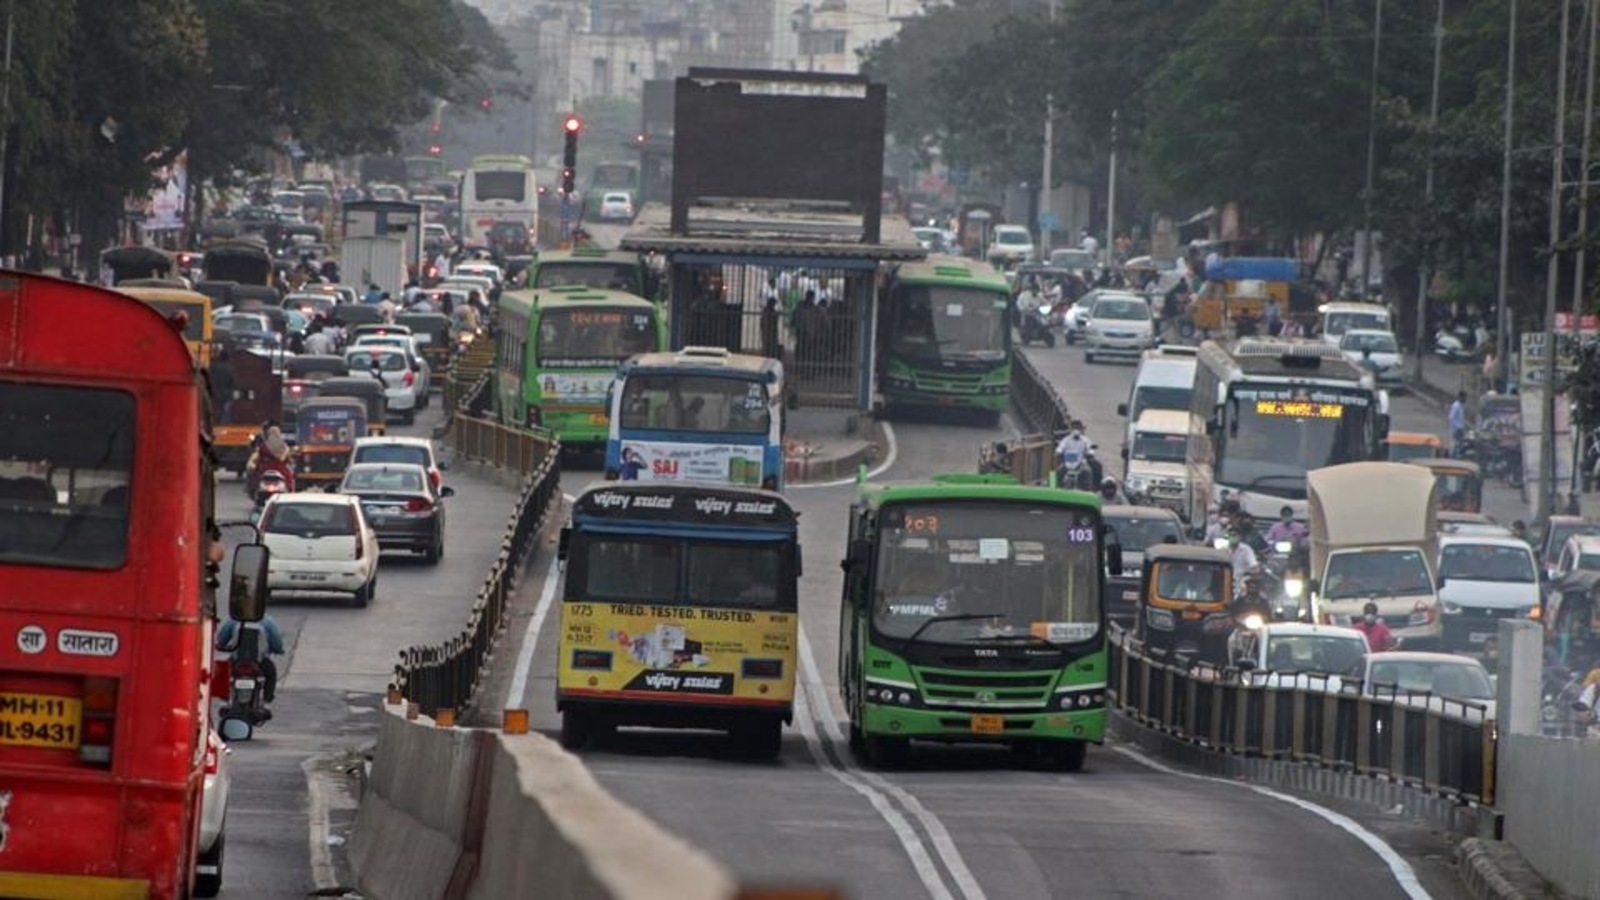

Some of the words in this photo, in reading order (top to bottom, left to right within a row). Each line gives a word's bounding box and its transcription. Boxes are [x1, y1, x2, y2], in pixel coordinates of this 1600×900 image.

[1069, 529, 1093, 542] 103
[651, 606, 697, 619] TESTED.
[701, 609, 755, 623] TRUSTED.
[21, 631, 43, 649] सा
[62, 633, 115, 652] सातारा
[974, 649, 999, 657] TATA
